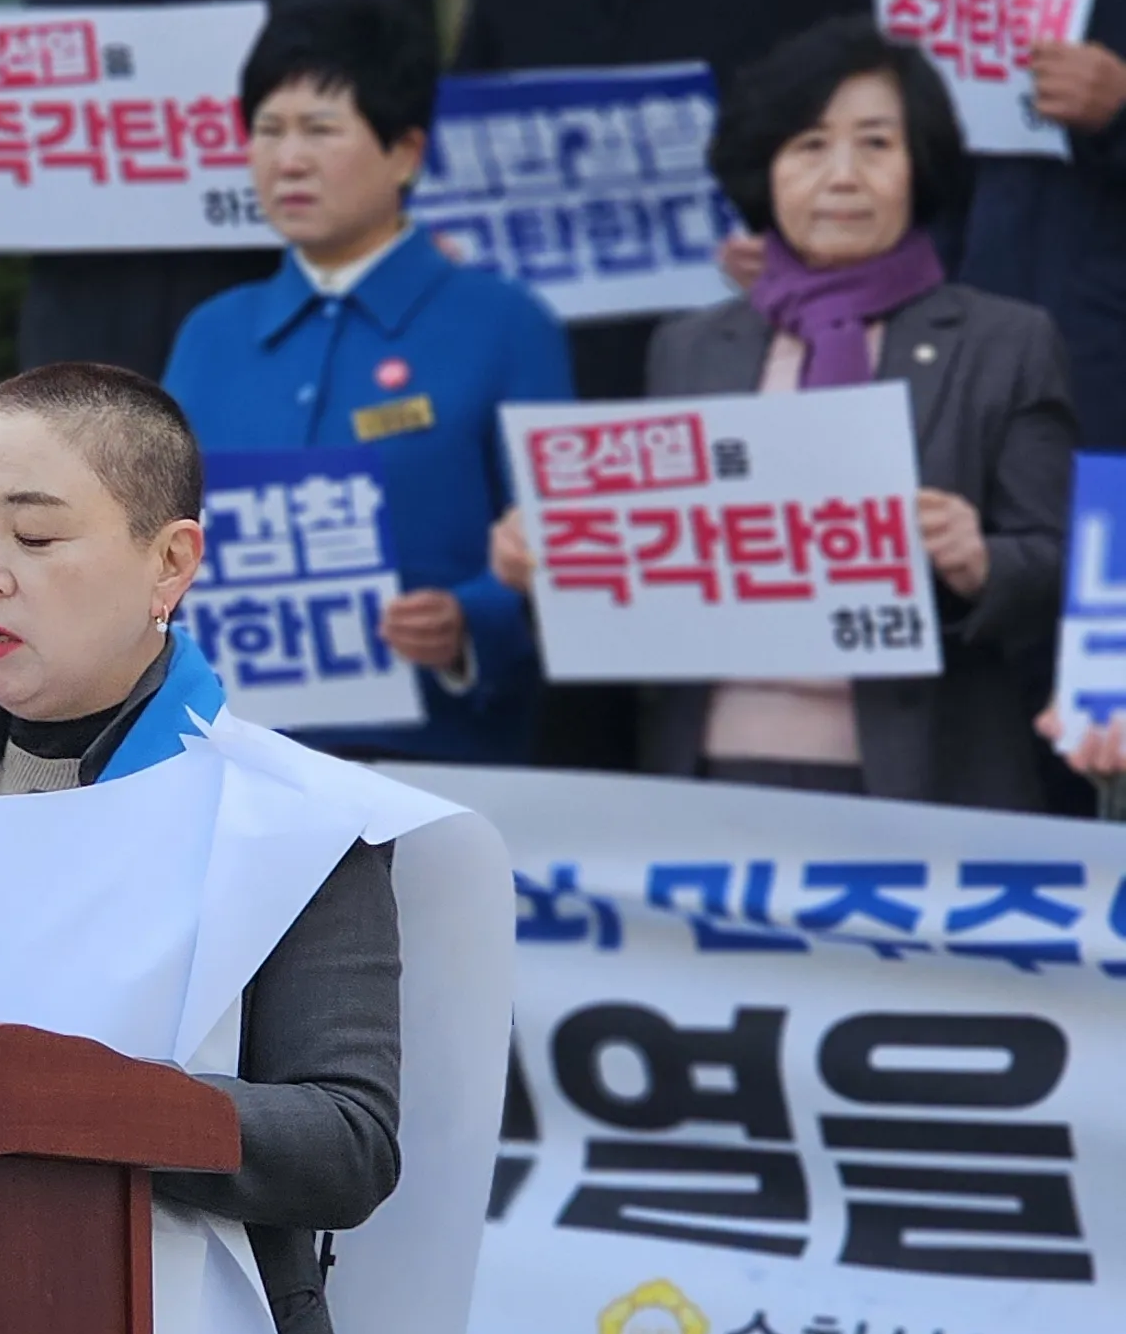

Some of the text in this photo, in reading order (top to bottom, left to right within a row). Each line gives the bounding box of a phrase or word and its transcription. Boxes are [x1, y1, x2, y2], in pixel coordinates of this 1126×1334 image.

[192, 475, 384, 581] 검찰
[541, 494, 915, 606] 즉각탄핵
[831, 606, 924, 651] 하라
[486, 1002, 1096, 1284] 열을
